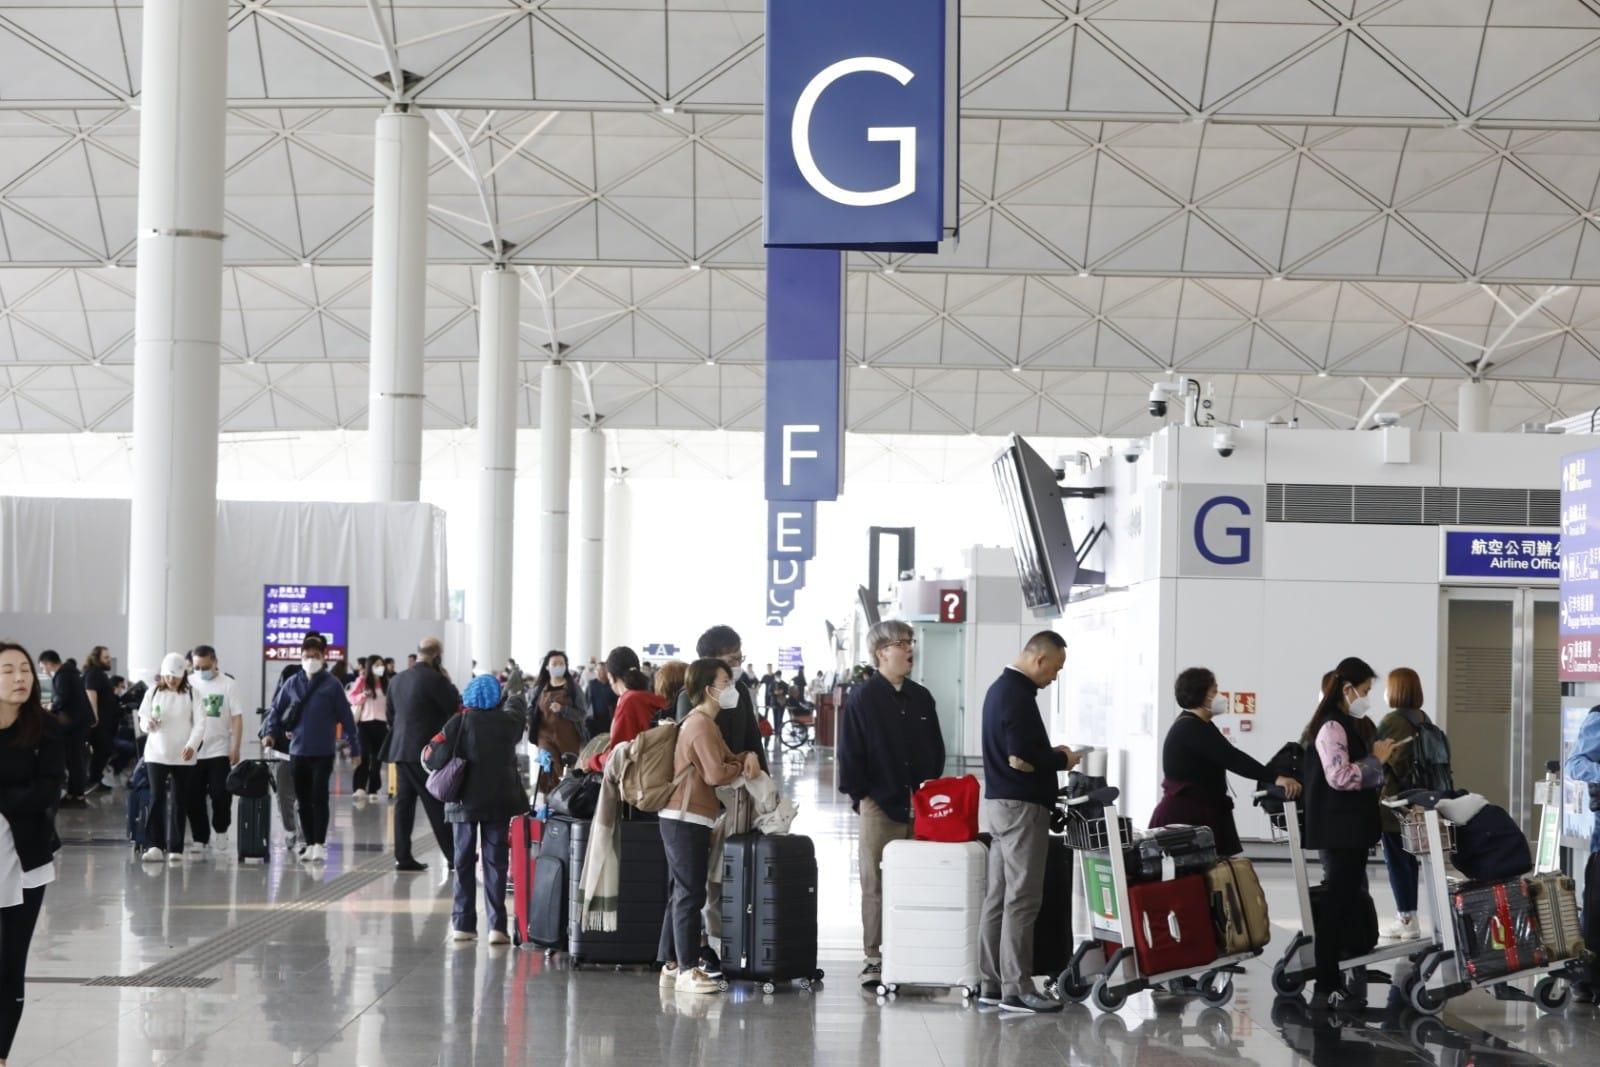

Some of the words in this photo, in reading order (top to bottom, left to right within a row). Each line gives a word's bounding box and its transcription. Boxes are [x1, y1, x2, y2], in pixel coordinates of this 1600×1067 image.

[791, 56, 917, 206] G
[782, 425, 820, 486] F
[777, 512, 802, 552] E
[1193, 495, 1251, 565] G
[1490, 557, 1529, 569] Airline
